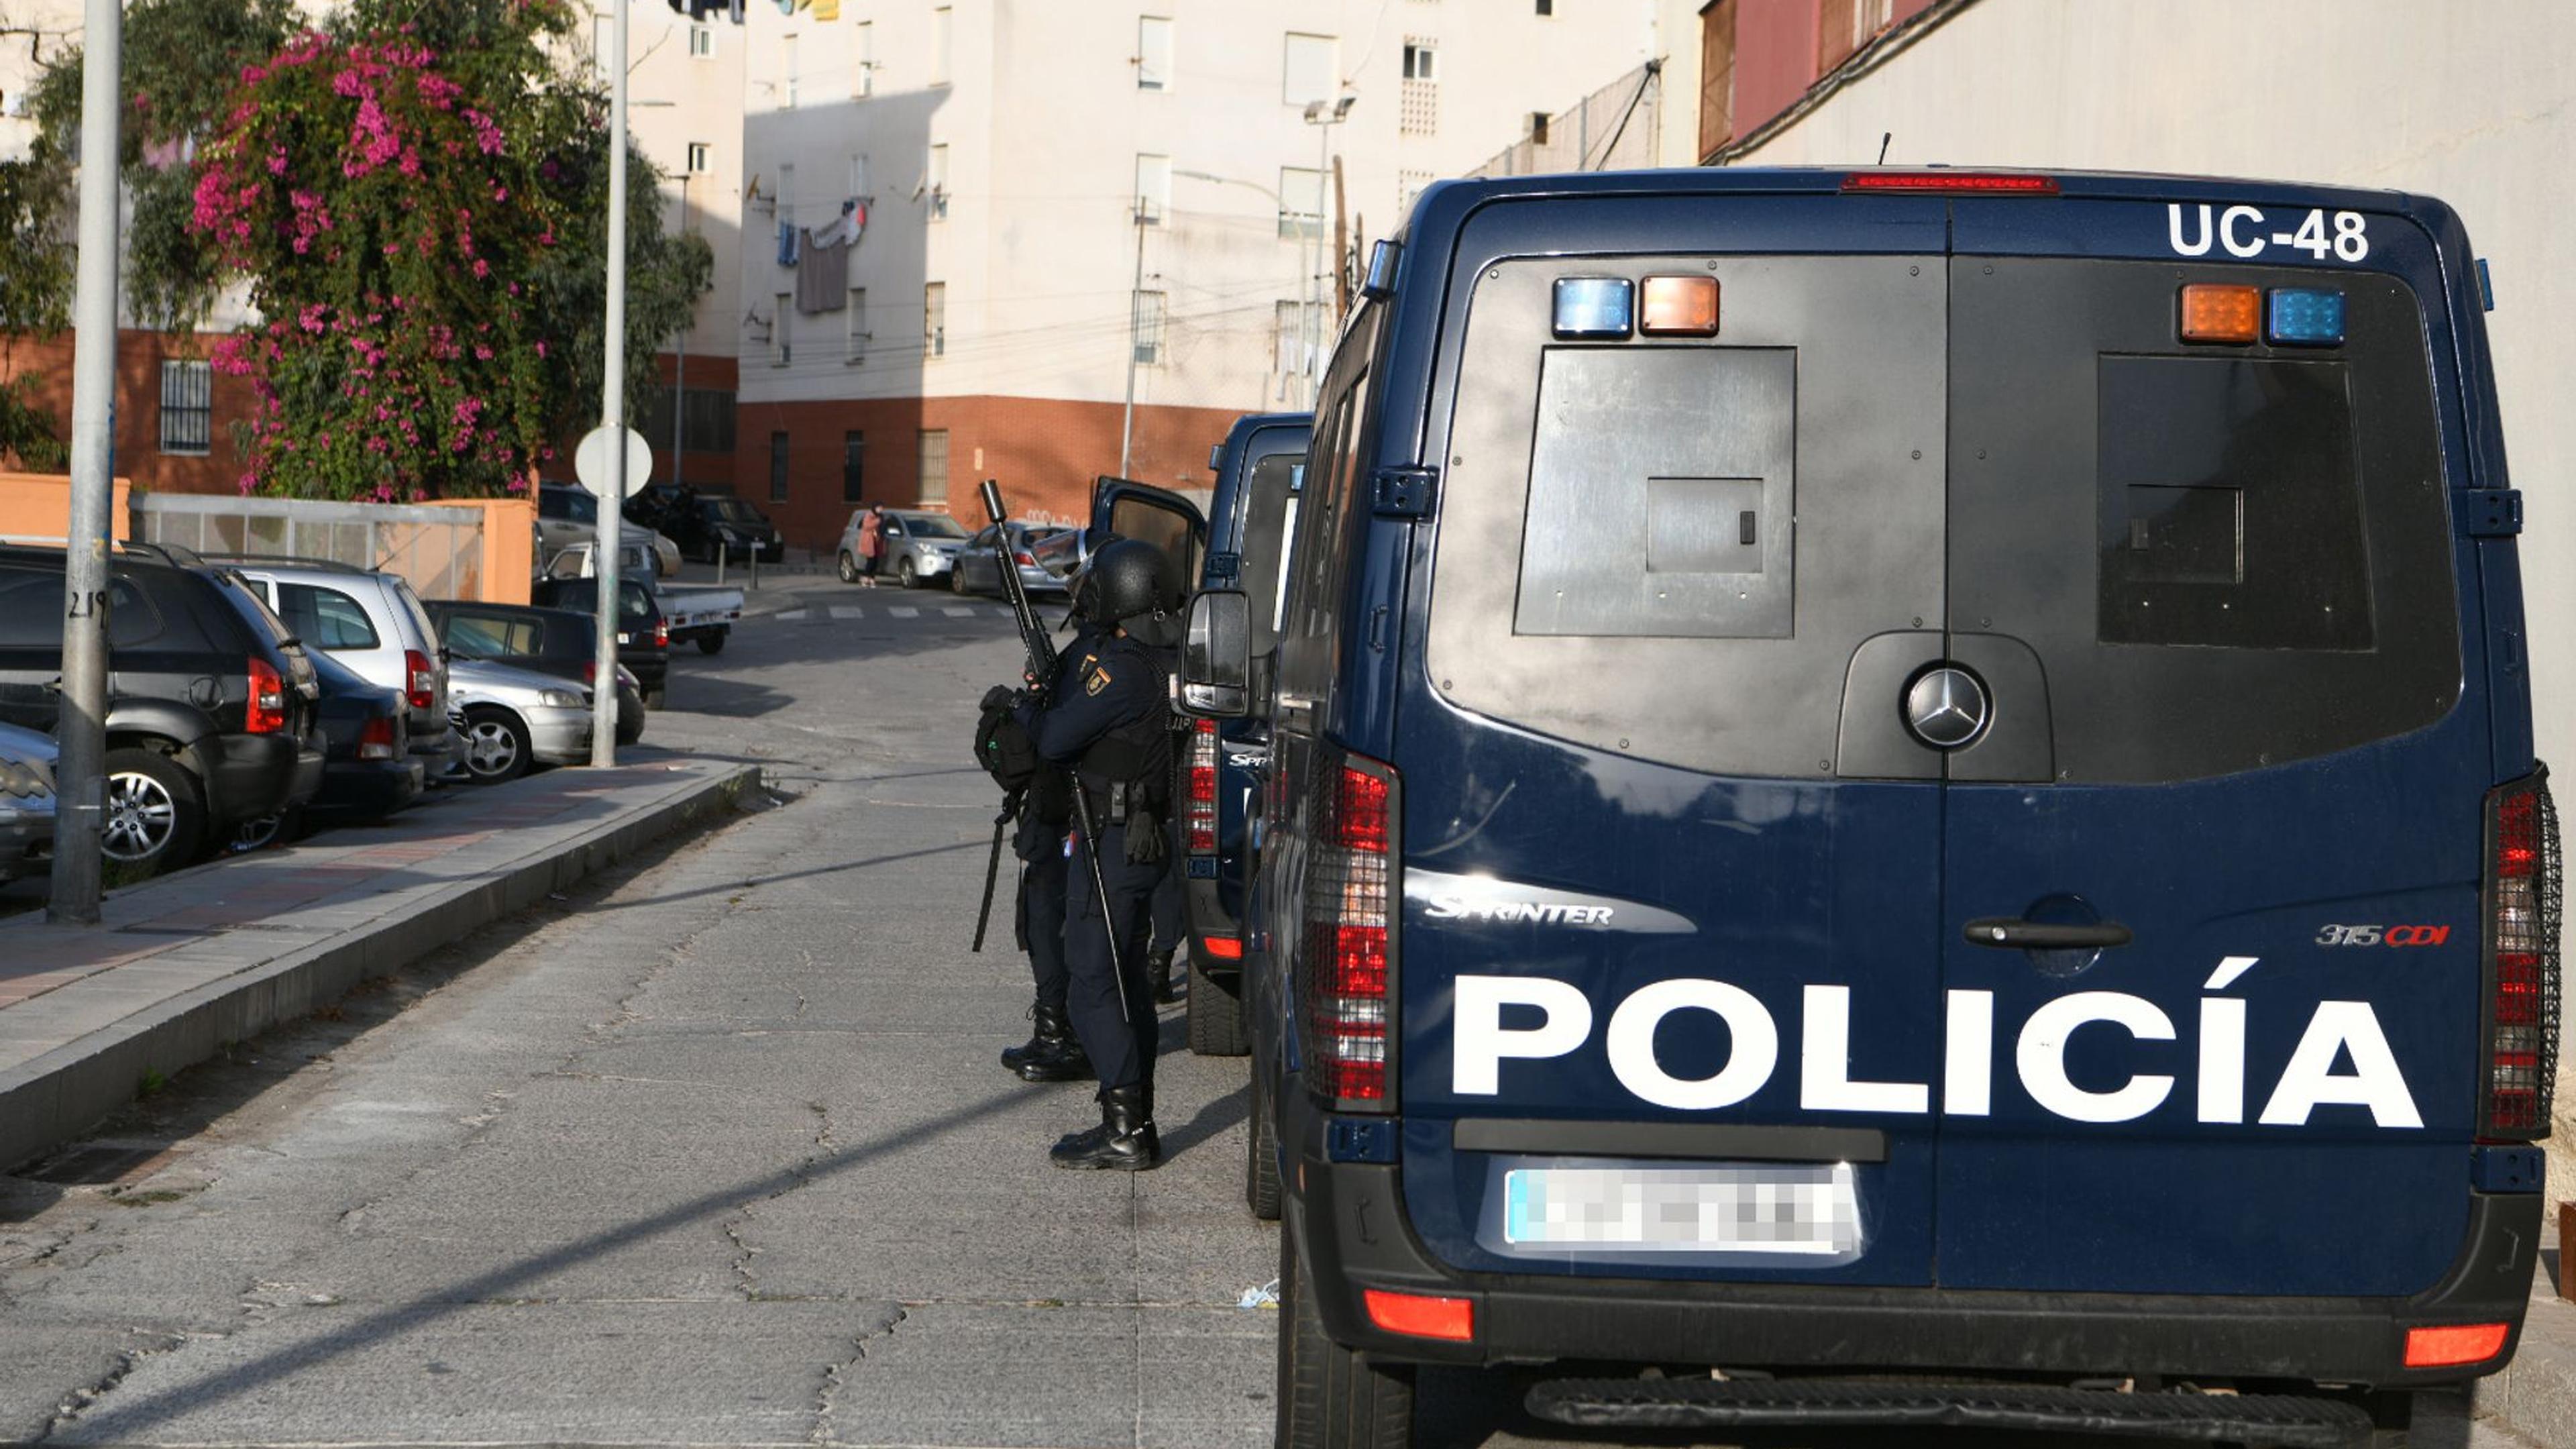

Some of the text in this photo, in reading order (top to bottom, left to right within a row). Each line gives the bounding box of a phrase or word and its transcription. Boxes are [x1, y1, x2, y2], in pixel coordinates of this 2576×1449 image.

[2168, 203, 2369, 262] UC-48
[68, 592, 107, 630] 219
[1425, 894, 1613, 926] SPRINTER
[2316, 924, 2451, 947] 315 CDI
[1452, 956, 2424, 1128] POLICÍA
